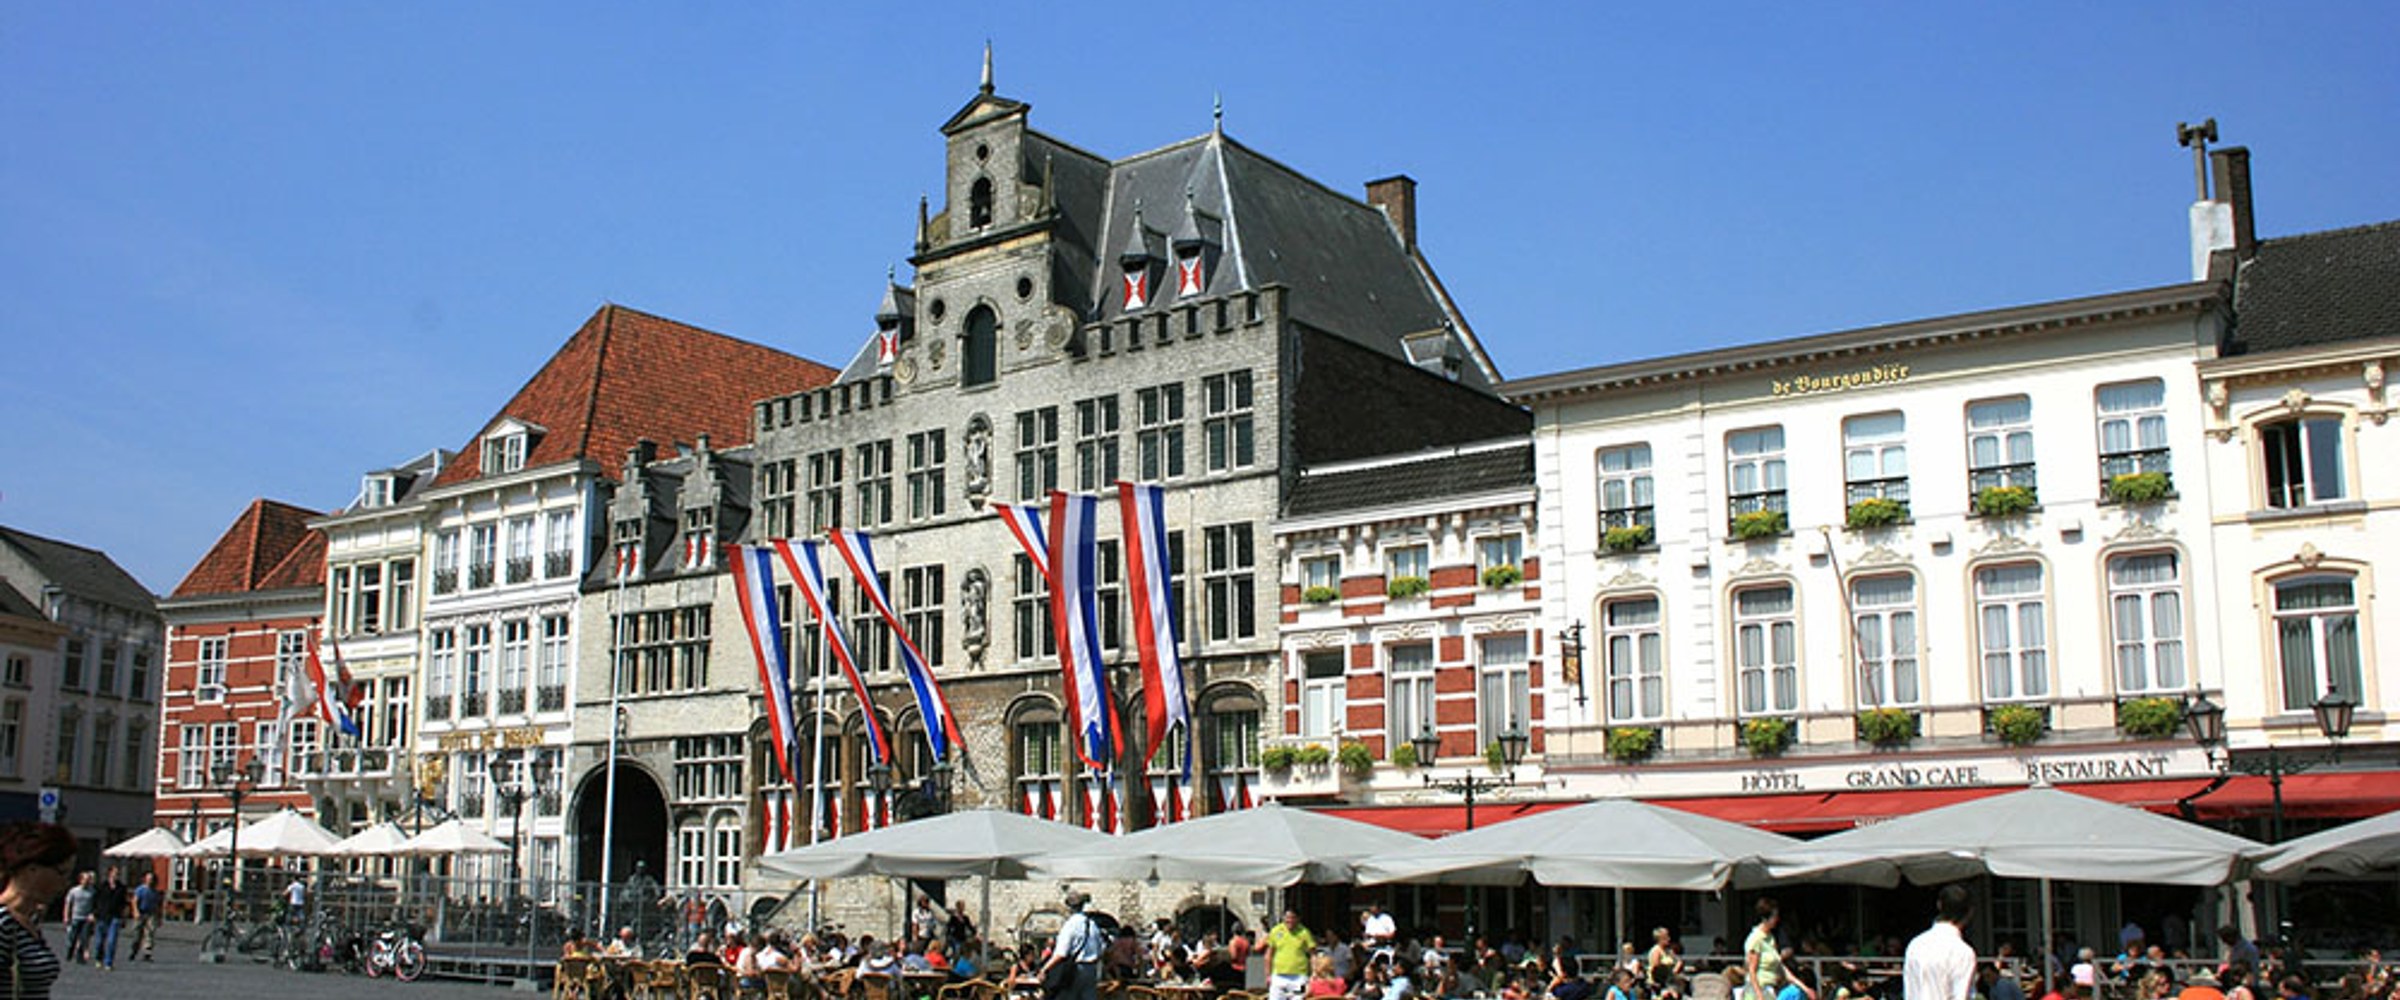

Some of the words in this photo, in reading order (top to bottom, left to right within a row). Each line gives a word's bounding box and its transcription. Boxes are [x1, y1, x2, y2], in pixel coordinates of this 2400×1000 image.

[1772, 380, 1791, 395] de
[1741, 773, 1805, 791] HOTEL
[1846, 767, 1921, 787] GRAND
[2026, 757, 2170, 780] RESTAURANT
